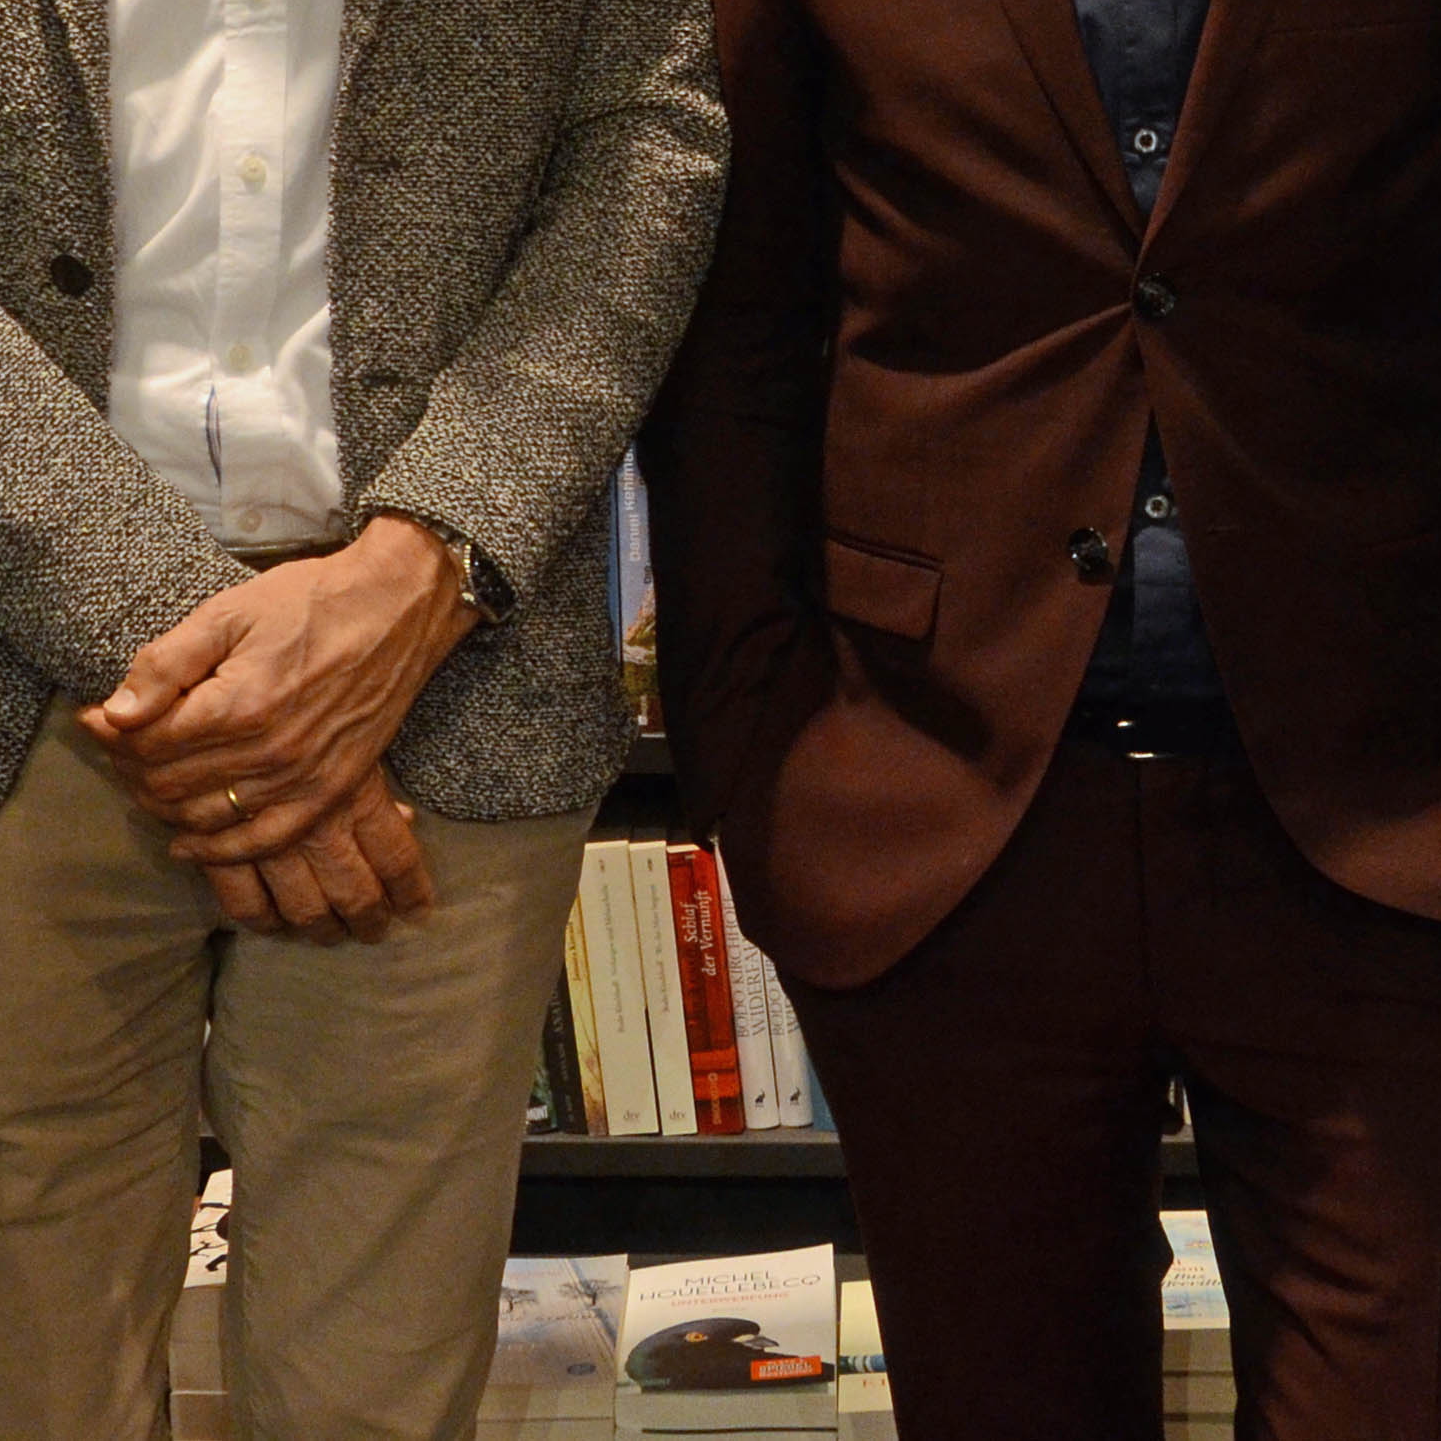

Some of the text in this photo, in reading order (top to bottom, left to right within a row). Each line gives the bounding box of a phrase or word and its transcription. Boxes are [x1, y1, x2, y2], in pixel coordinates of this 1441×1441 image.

[680, 901, 700, 942] Schlaf
[696, 889, 716, 950] Vernunft
[703, 955, 717, 976] der
[733, 990, 749, 1037] BODO
[640, 1273, 822, 1302] HOUELLEBECQ
[685, 1271, 775, 1287] MICHEL
